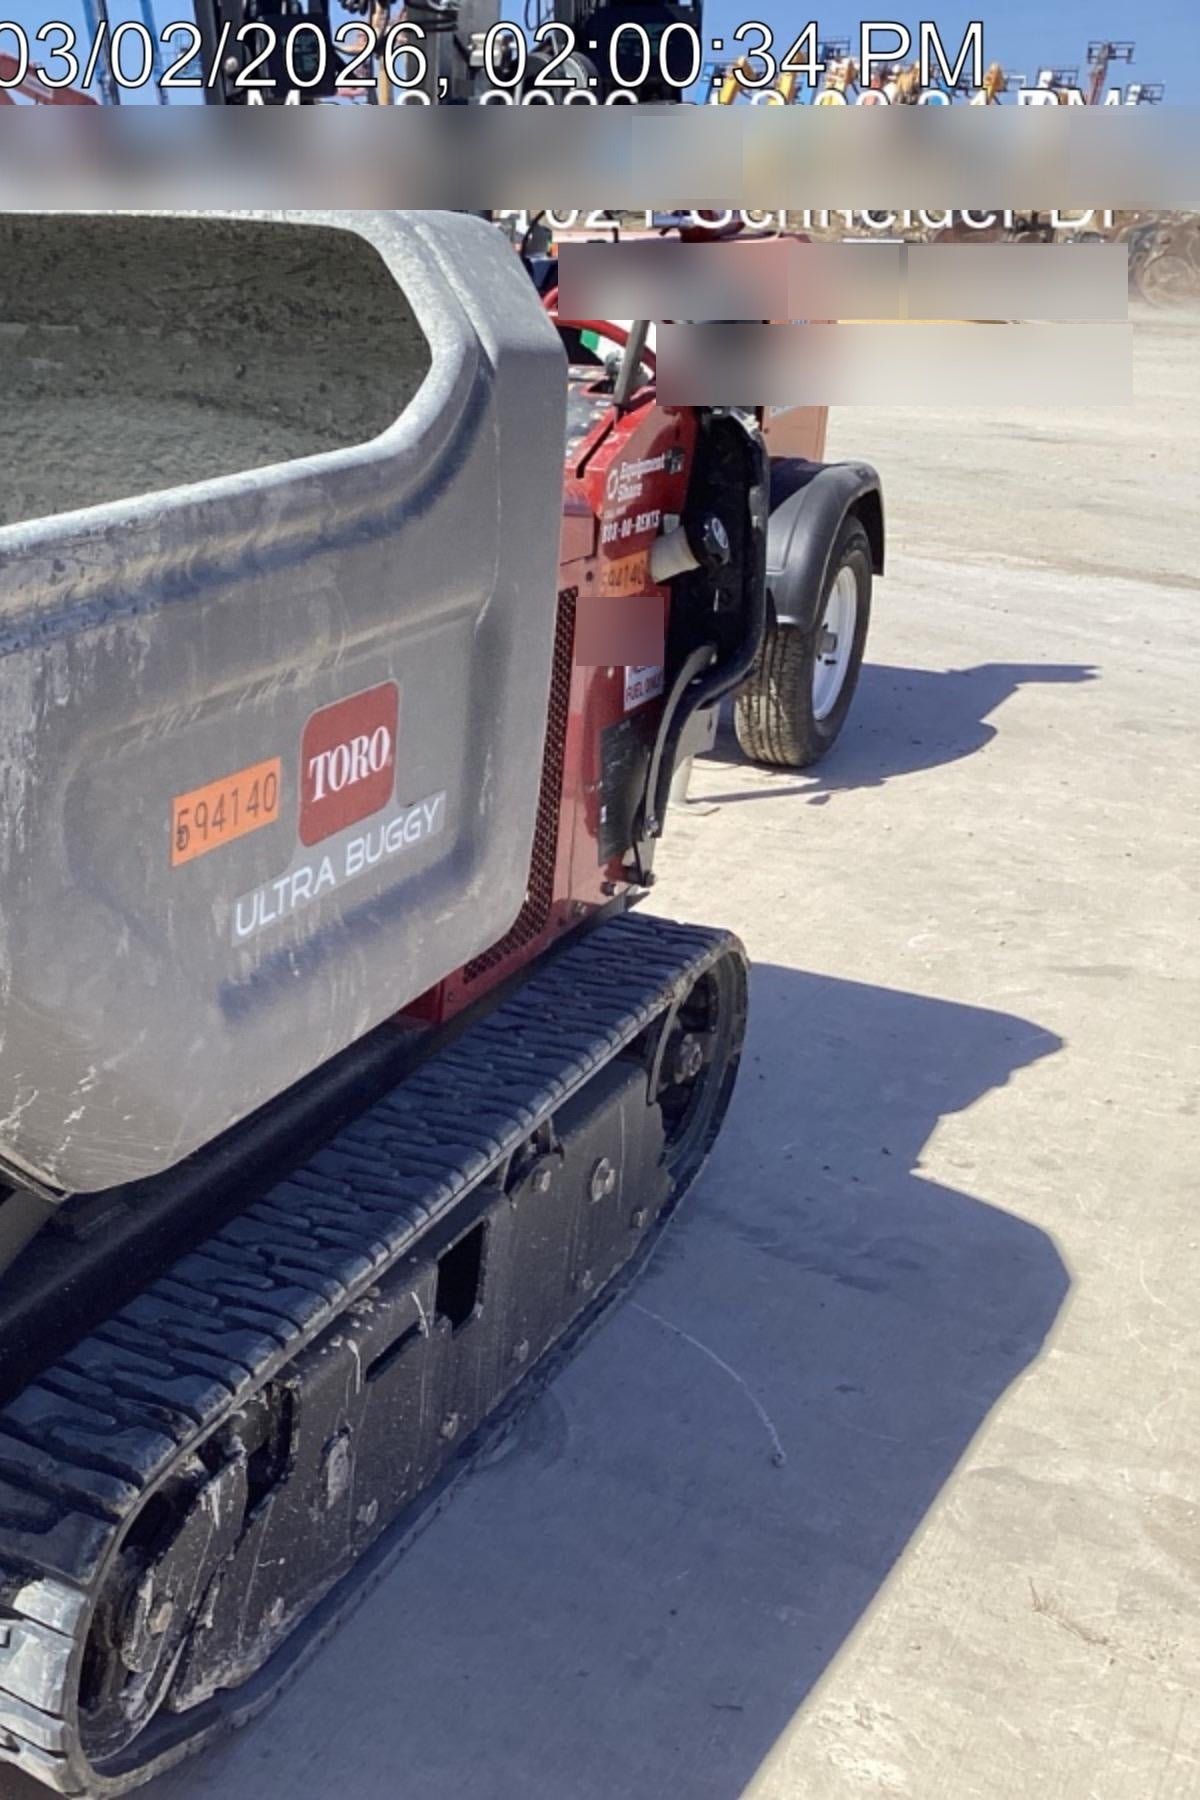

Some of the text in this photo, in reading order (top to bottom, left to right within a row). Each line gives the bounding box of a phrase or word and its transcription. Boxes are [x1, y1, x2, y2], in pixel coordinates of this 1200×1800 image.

[308, 725, 392, 803] TORO
[234, 796, 441, 938] ULTRA BUGGY
